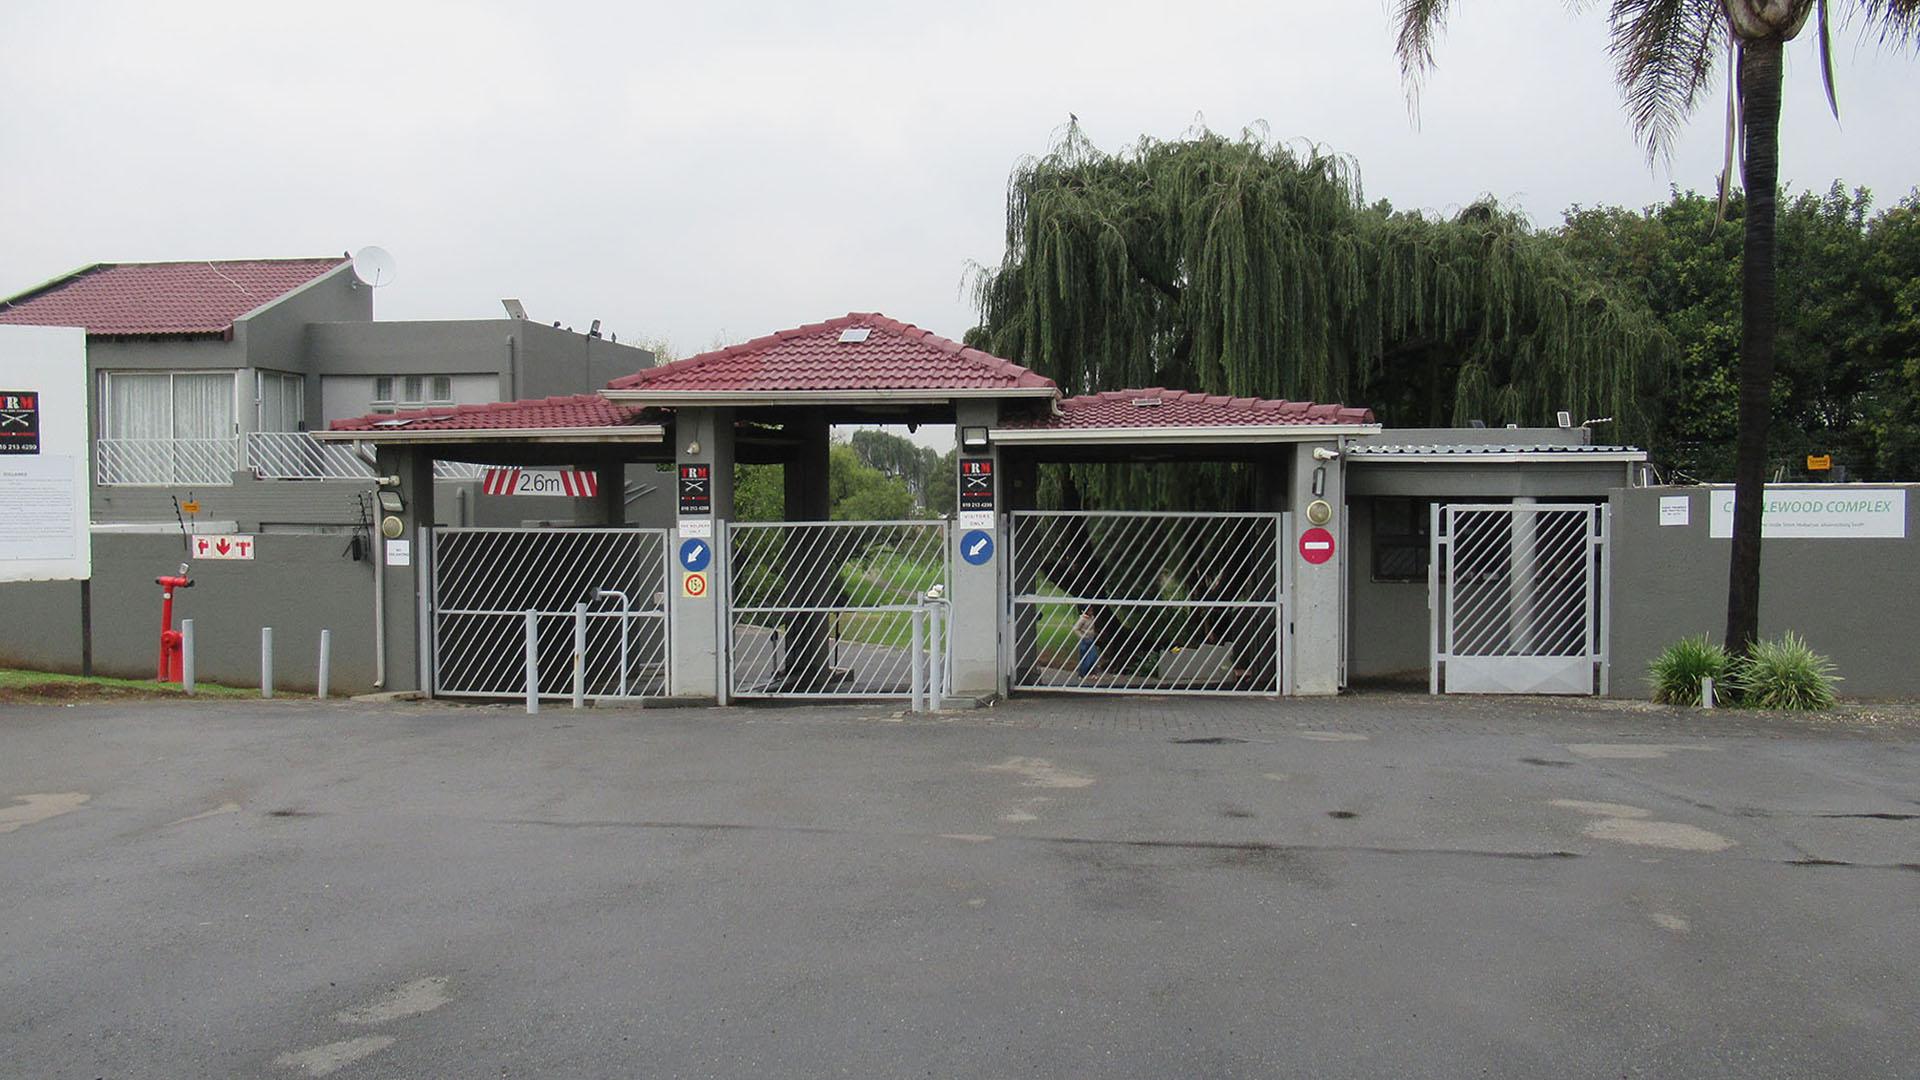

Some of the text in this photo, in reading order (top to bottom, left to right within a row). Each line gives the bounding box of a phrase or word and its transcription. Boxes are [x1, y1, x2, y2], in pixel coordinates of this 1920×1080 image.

[681, 467, 708, 478] TRM
[963, 463, 991, 474] TRM
[520, 474, 560, 491] 2.6m
[1723, 500, 1892, 513] CLEWOOD COMPLEX
